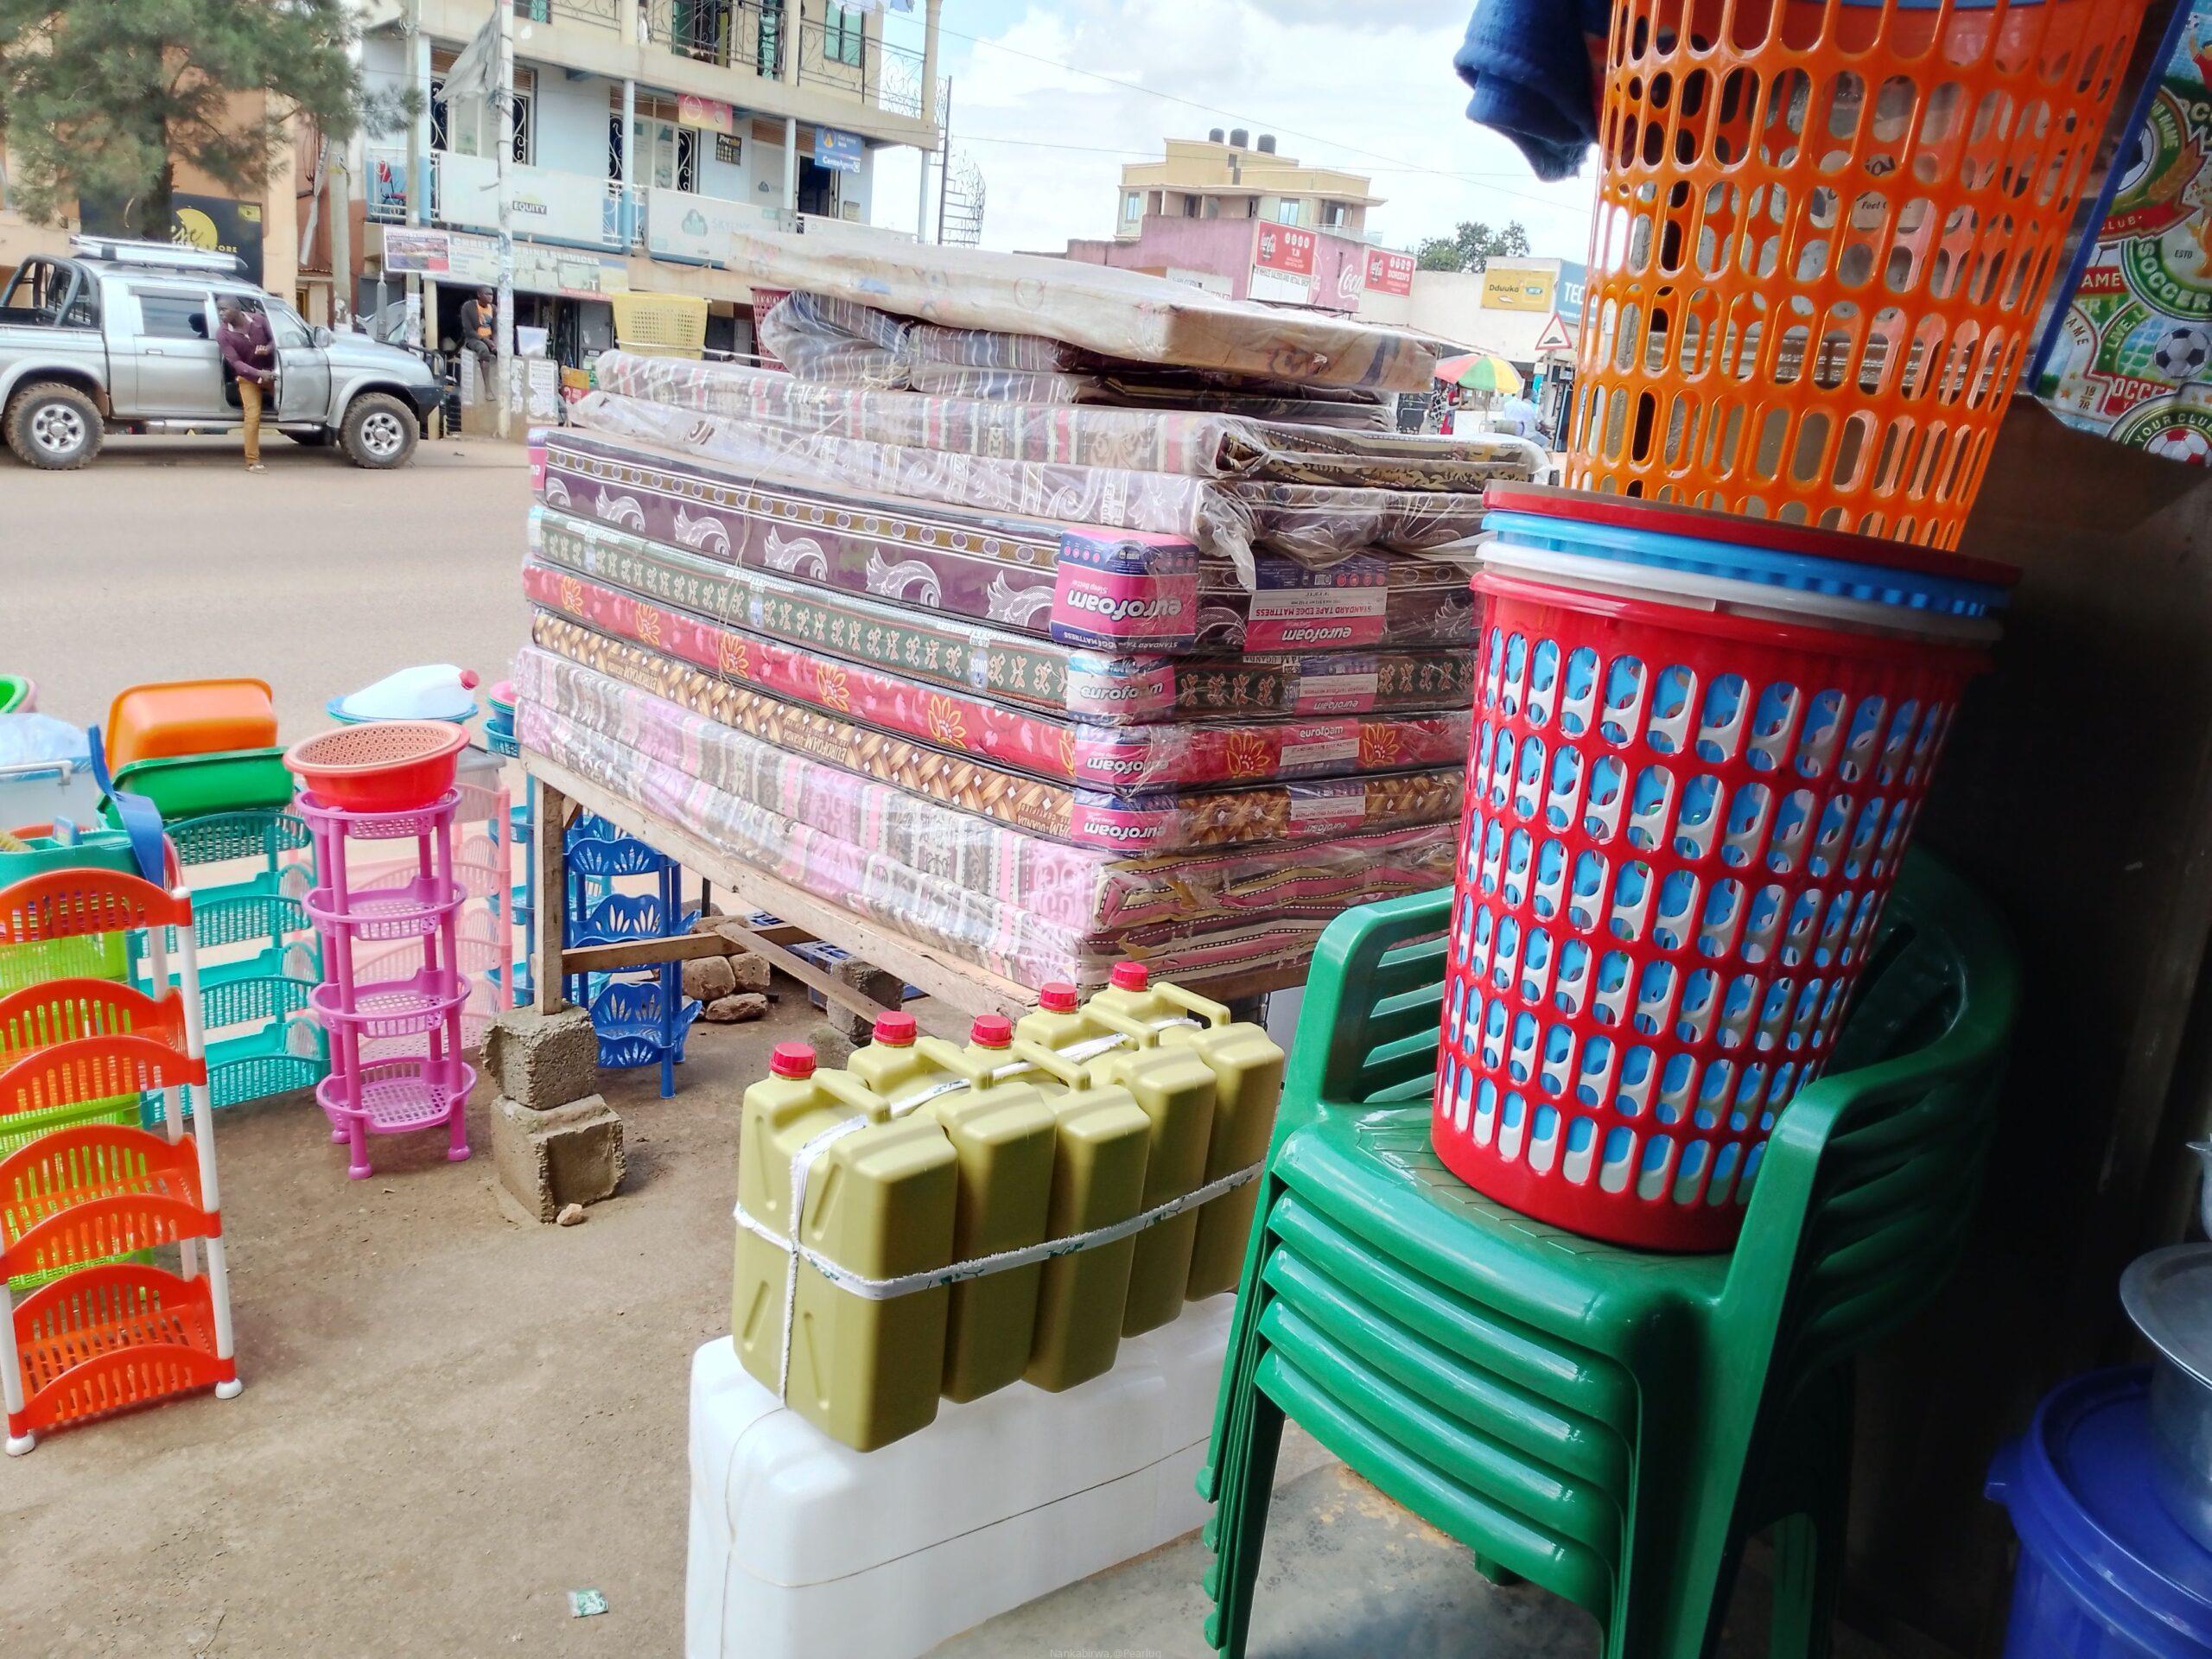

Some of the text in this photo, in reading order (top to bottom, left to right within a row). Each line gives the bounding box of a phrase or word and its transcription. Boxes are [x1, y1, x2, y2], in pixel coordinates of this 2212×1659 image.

[513, 201, 547, 214] EQUITY
[2081, 273, 2121, 289] AME
[2134, 415, 2172, 443] YOUR
[1067, 589, 1182, 621] eurofoam
[1255, 606, 1372, 617] STANDARD TAPE EDGE MATTRESS
[1282, 626, 1352, 644] eurofoam
[1080, 682, 1163, 700] eurofom
[1300, 726, 1344, 738] eurofoam
[1084, 822, 1166, 842] eurofoam
